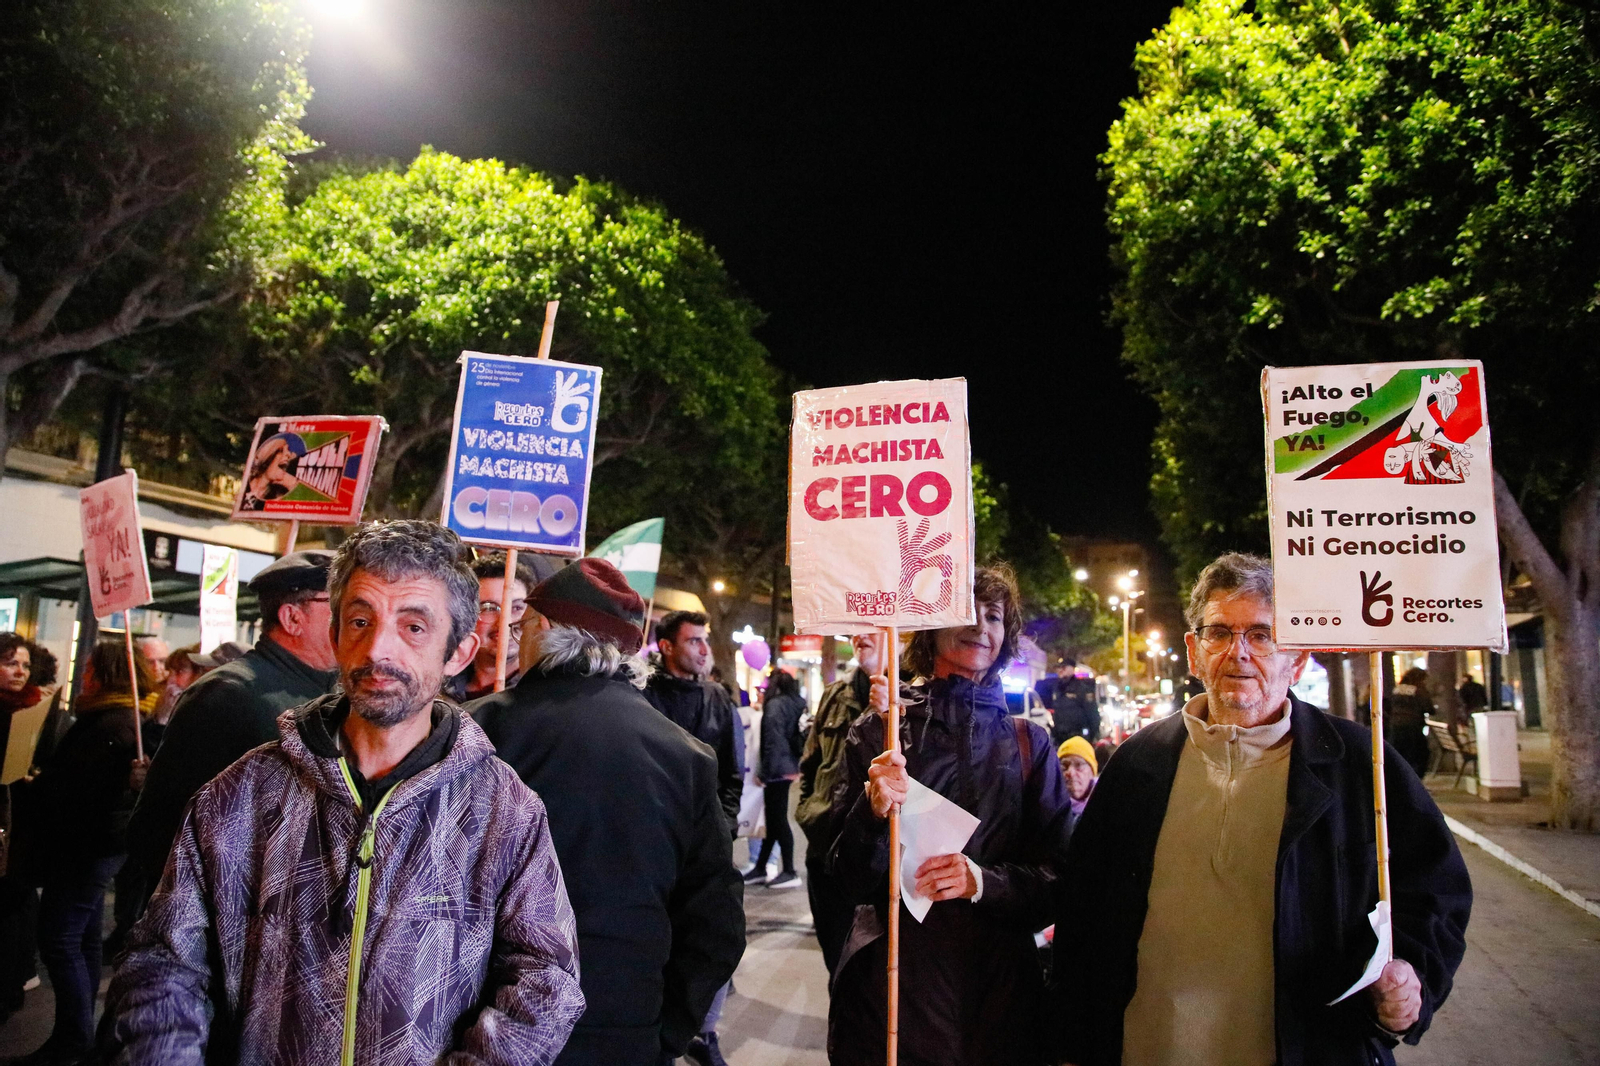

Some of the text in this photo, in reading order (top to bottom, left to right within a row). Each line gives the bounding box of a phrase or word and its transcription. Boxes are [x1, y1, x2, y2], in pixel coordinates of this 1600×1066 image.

[471, 362, 486, 373] 25
[1281, 382, 1373, 404] ¡Alto el
[494, 401, 544, 420] Recortes
[504, 415, 541, 427] CERO
[807, 402, 951, 431] VIOLENCIA
[1283, 409, 1369, 428] Fuego,
[463, 427, 584, 459] VIOLENCIA
[812, 438, 945, 467] MACHISTA
[1284, 434, 1326, 452] YA!
[459, 454, 570, 485] MACHISTA
[804, 471, 953, 522] CERO
[453, 486, 579, 537] CERO
[1287, 506, 1476, 528] Ni Terrorismo
[1288, 533, 1466, 556] Ni Genocidio
[846, 590, 897, 612] Recortes
[857, 603, 896, 616] CERO
[1403, 597, 1483, 610] Recortes
[1403, 609, 1455, 623] Cero.
